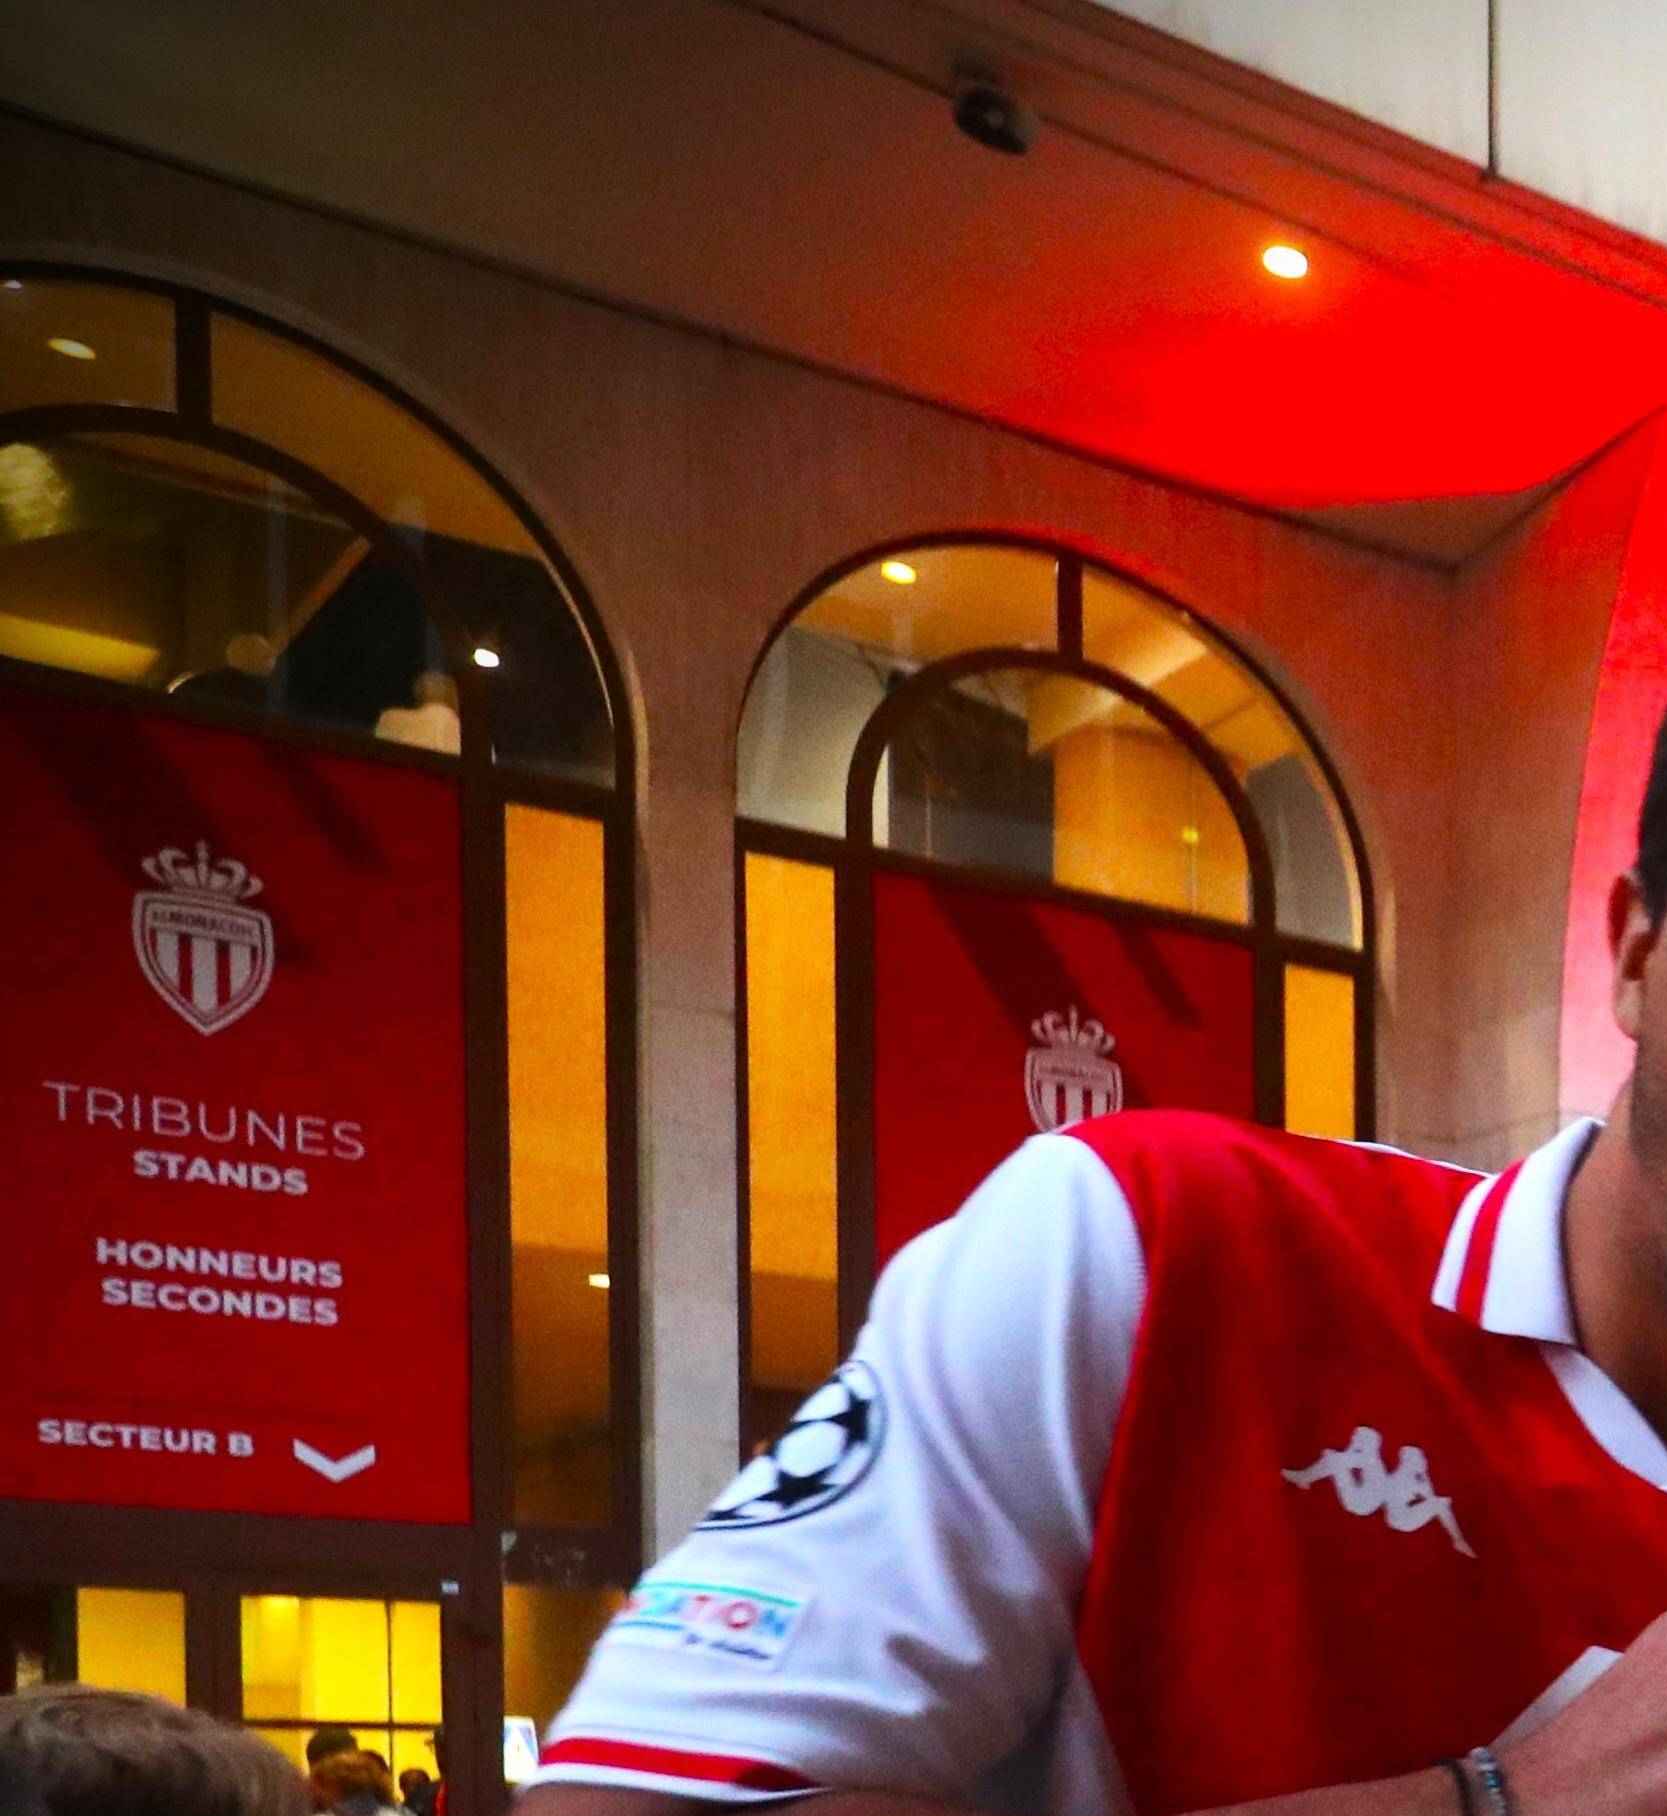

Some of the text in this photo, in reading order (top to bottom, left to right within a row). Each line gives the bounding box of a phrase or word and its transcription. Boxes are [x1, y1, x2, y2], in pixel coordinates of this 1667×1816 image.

[43, 1079, 366, 1161] TRIBUNES
[133, 1148, 309, 1196] STANDS
[96, 1237, 343, 1288] HONNEURS
[102, 1277, 339, 1326] SECONDES
[38, 1419, 254, 1457] SECTEUR B
